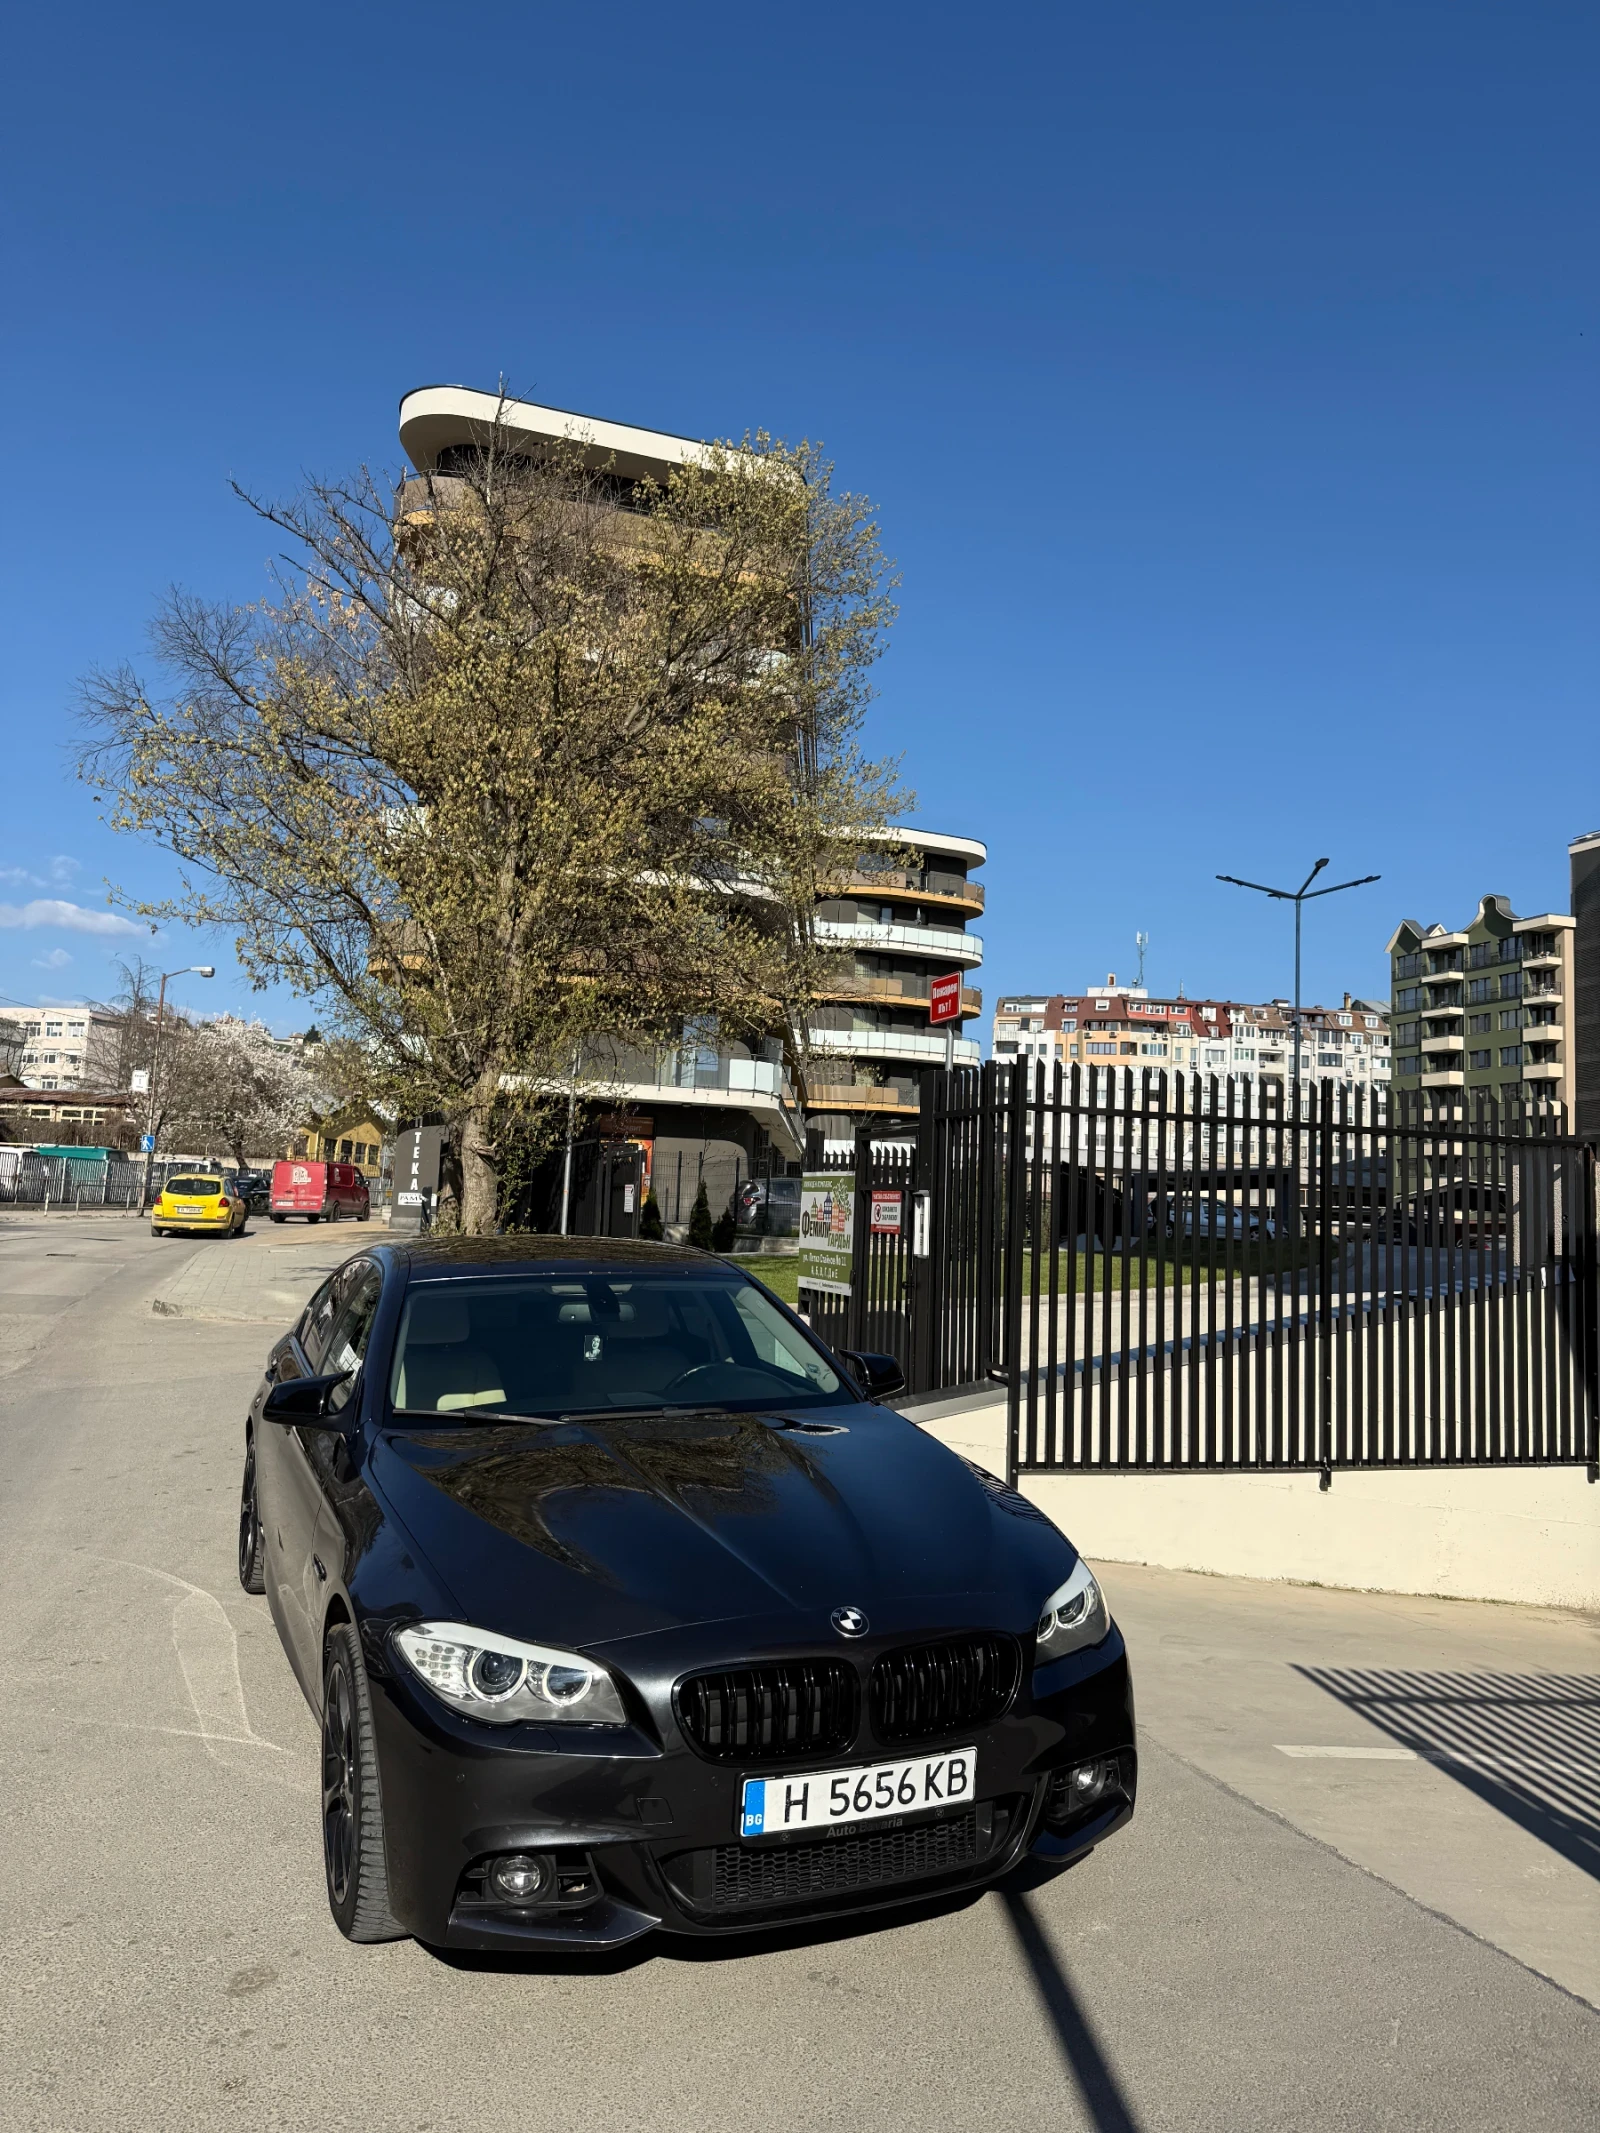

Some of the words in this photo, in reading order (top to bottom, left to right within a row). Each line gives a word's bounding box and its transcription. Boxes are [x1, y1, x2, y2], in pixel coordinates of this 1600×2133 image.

[932, 982, 958, 1000] Пожарен
[938, 1000, 952, 1014] път!
[827, 1232, 851, 1250] ГАРДЪН
[829, 1767, 917, 1816] 5656
[745, 1813, 763, 1826] BG
[826, 1825, 857, 1838] Auto
[859, 1817, 903, 1834] Bavaria
